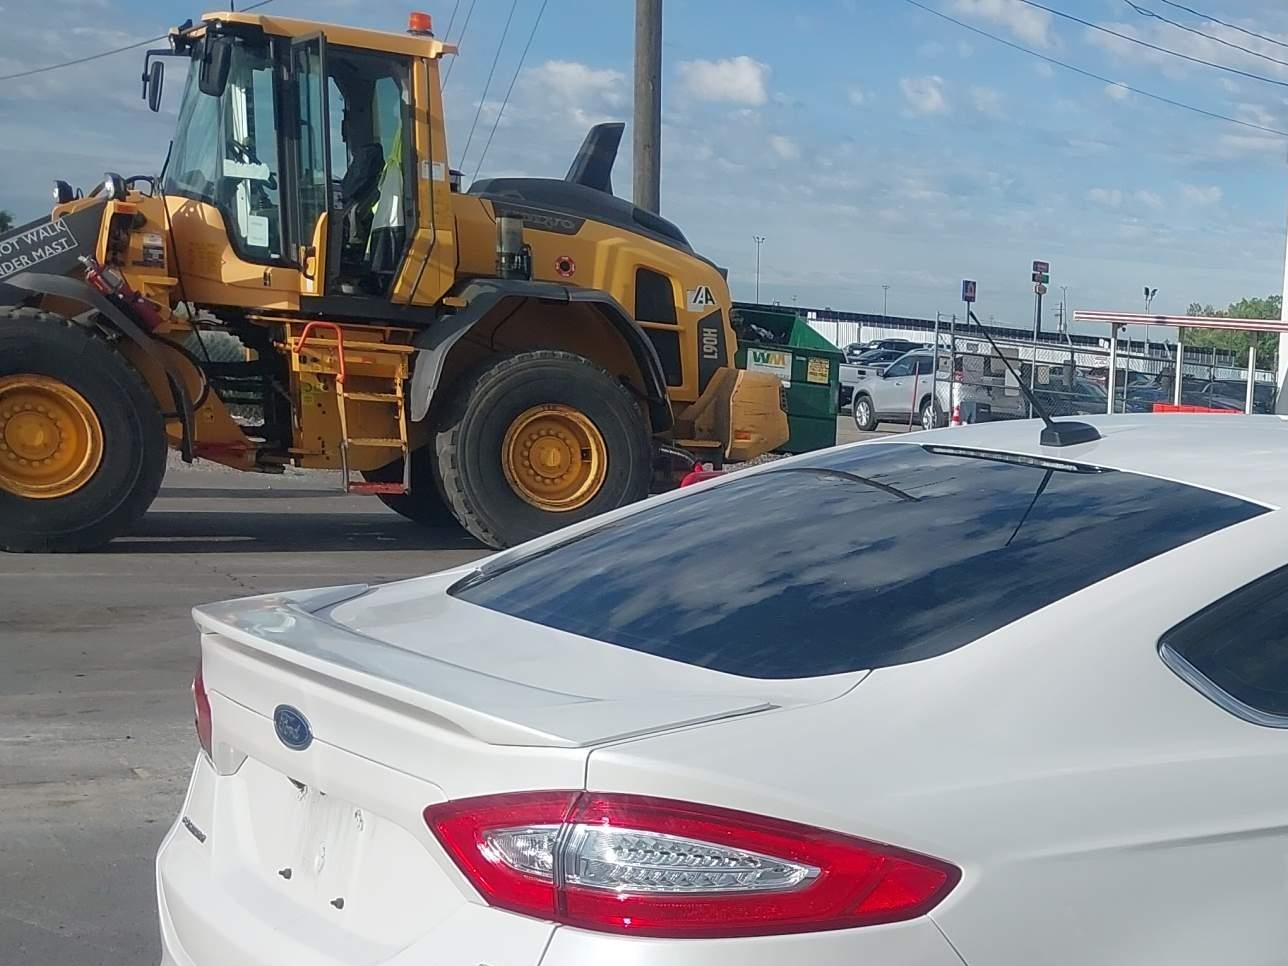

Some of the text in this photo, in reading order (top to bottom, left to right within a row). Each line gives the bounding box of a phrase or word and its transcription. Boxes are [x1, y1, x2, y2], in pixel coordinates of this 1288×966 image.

[0, 220, 66, 257] OT WALK
[31, 237, 70, 262] MAST
[702, 327, 718, 360] L90H
[752, 351, 786, 366] WM
